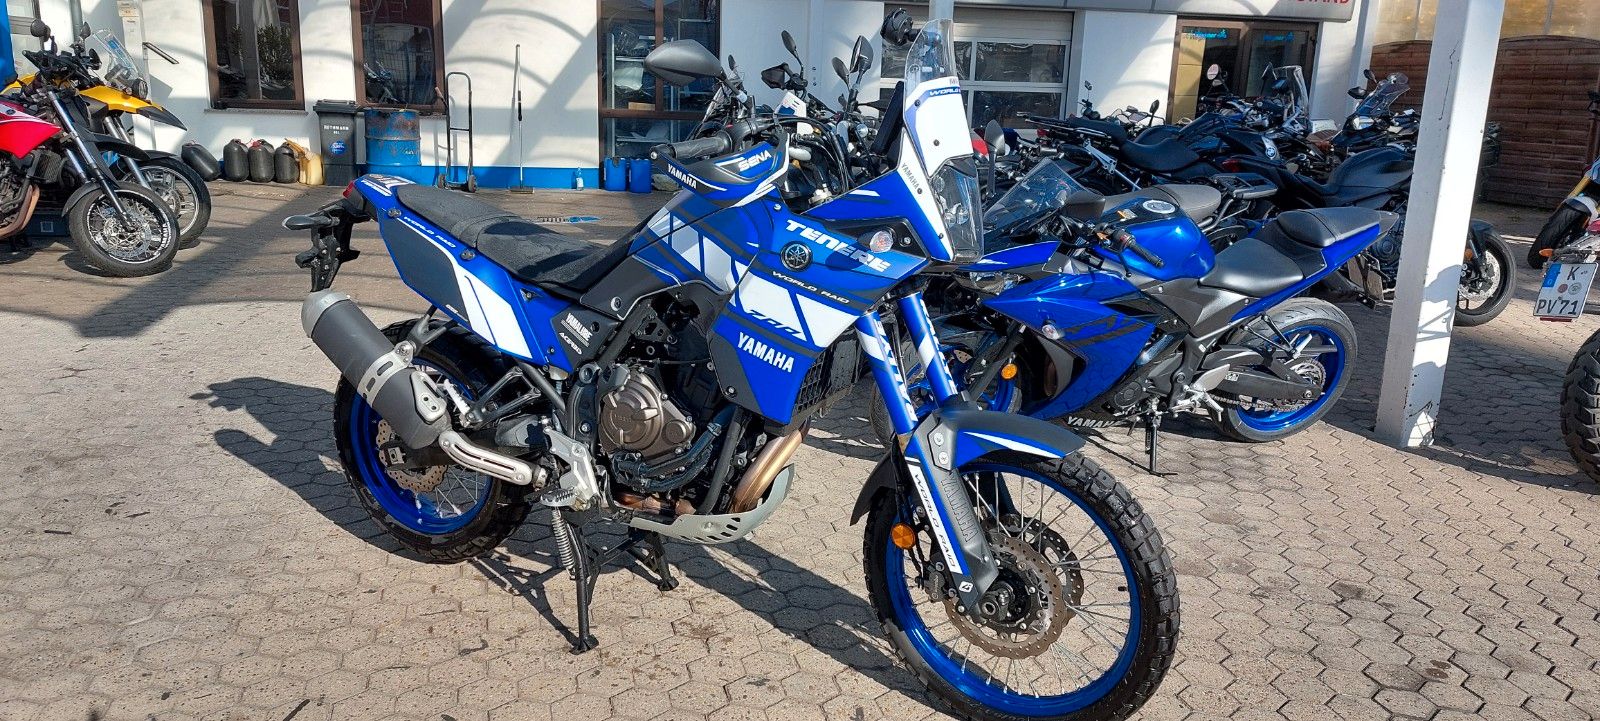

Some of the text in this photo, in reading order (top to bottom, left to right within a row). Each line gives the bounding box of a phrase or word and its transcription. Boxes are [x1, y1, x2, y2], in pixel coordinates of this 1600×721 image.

[667, 163, 697, 190] YAMAHA
[737, 149, 773, 172] SENA
[901, 162, 919, 190] YAMAHA
[785, 219, 891, 273] TENERE
[772, 270, 850, 305] WORLD RAID
[1567, 266, 1580, 280] K
[737, 331, 795, 373] YAMAHA
[915, 474, 956, 568] WORLD RAID
[940, 468, 980, 543] YAMAHA
